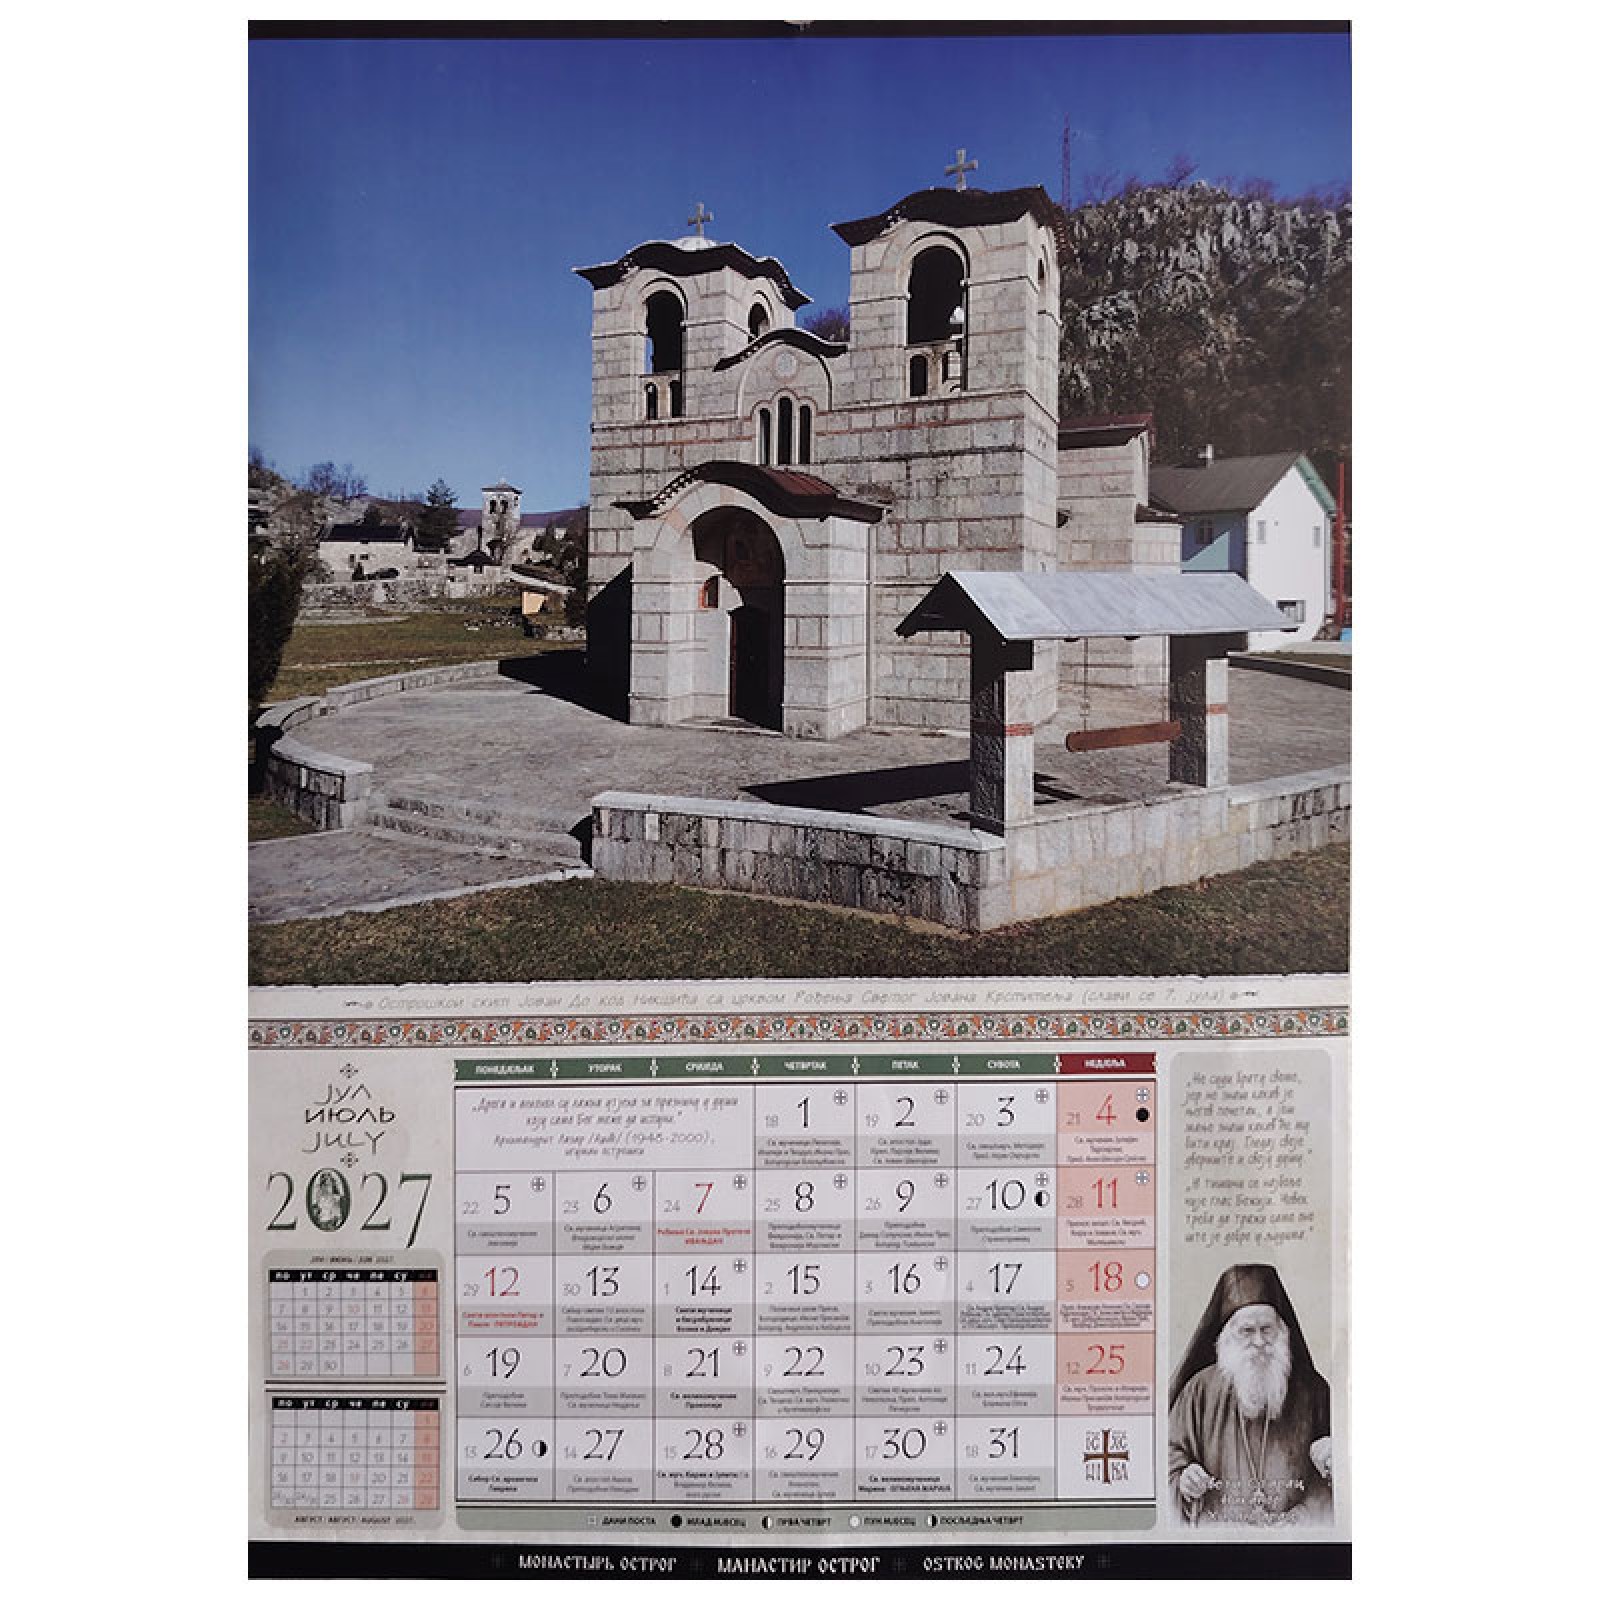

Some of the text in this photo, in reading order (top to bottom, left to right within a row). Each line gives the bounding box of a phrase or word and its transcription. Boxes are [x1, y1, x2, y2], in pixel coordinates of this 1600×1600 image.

[891, 1060, 920, 1070] ПЕТАК
[987, 1059, 1021, 1069] СУБОТА
[313, 1084, 373, 1105] ЈУЛ
[1096, 1094, 1116, 1125] 4
[305, 1107, 396, 1123] ИЮЛЬ
[798, 1098, 808, 1128] 1
[896, 1098, 914, 1126] 2
[998, 1096, 1014, 1126] 3
[302, 1131, 386, 1154] JULY
[266, 1168, 432, 1248] 2027
[494, 1186, 510, 1214] 5
[594, 1184, 612, 1214] 6
[696, 1184, 712, 1214] 7
[796, 1182, 814, 1212] 8
[896, 1180, 914, 1212] 9
[986, 1180, 1026, 1210] 10
[1092, 1178, 1116, 1208] 11
[325, 1287, 333, 1297] 2
[485, 1267, 520, 1296] 12
[586, 1266, 618, 1296] 13
[686, 1266, 720, 1296] 14
[788, 1264, 820, 1294] 15
[890, 1264, 920, 1294] 16
[990, 1264, 1022, 1294] 17
[1090, 1262, 1122, 1292] 18
[347, 1340, 361, 1351] 24
[984, 1346, 1026, 1375] 24
[1086, 1345, 1124, 1374] 25
[486, 1348, 520, 1378] 19
[580, 1348, 626, 1376] 20
[686, 1348, 718, 1376] 21
[784, 1348, 824, 1376] 22
[886, 1346, 924, 1376] 23
[484, 1428, 522, 1458] 26
[584, 1430, 624, 1460] 27
[684, 1430, 724, 1460] 28
[784, 1428, 824, 1460] 29
[884, 1428, 926, 1458] 30
[990, 1428, 1018, 1458] 31
[520, 1554, 676, 1572] МОНАСТЫРЬ ОСТРОГ
[718, 1556, 880, 1574] МАНАСТИР ОСТРОГ
